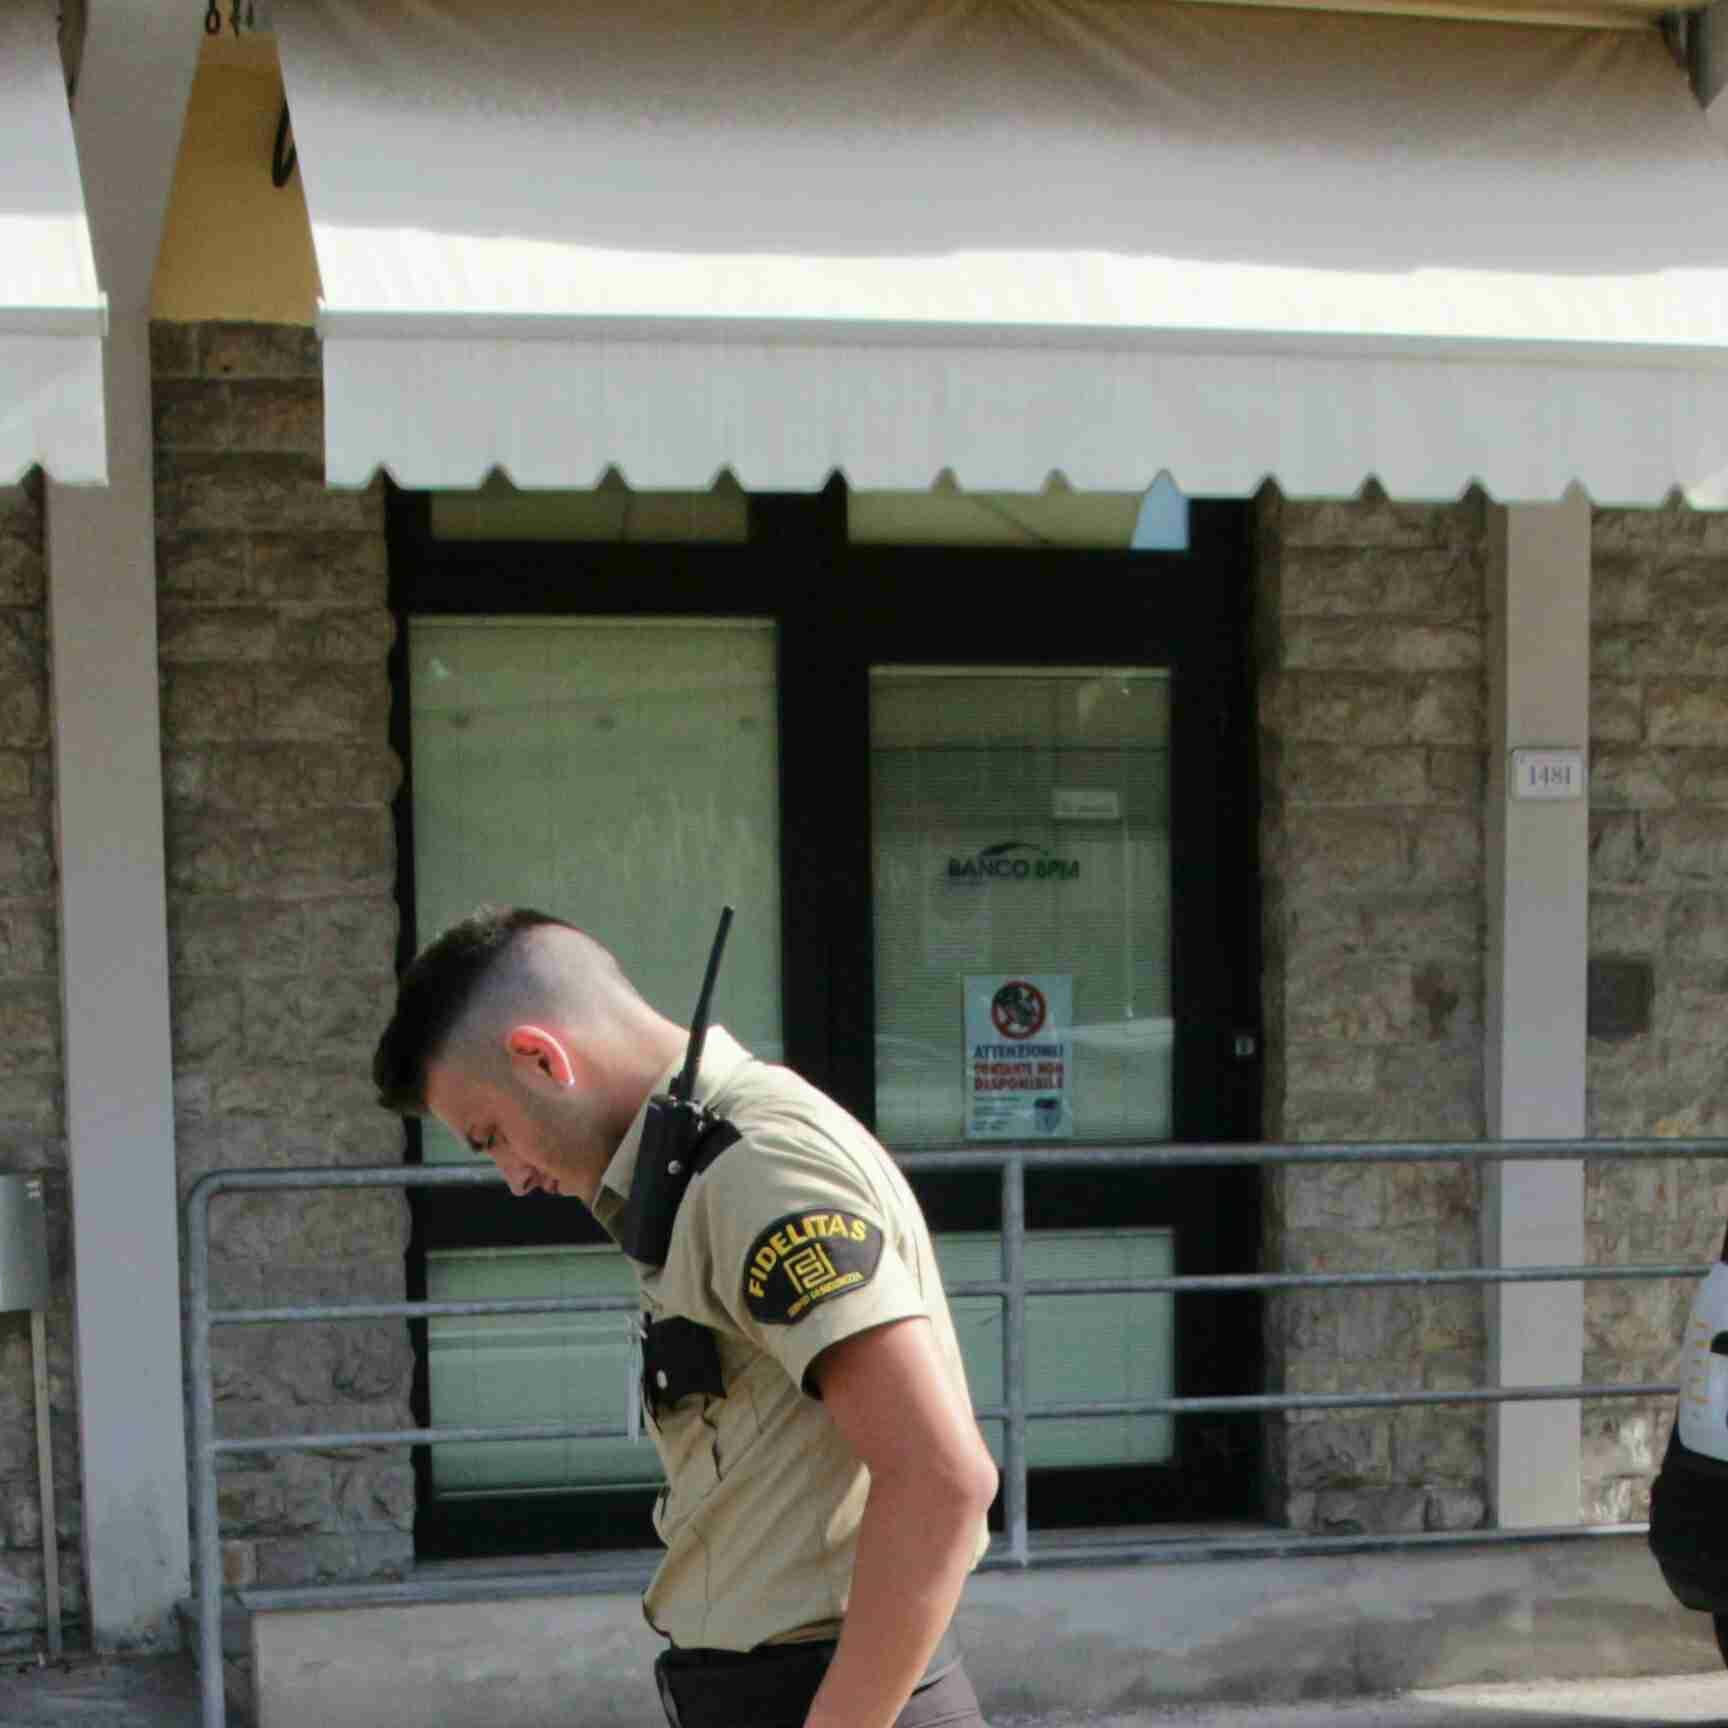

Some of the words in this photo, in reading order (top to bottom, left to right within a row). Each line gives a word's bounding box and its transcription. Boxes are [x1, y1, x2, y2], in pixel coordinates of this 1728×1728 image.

[1528, 764, 1571, 787] 1481
[949, 857, 1029, 879] BANCO
[749, 1214, 866, 1297] FIDELITAS
